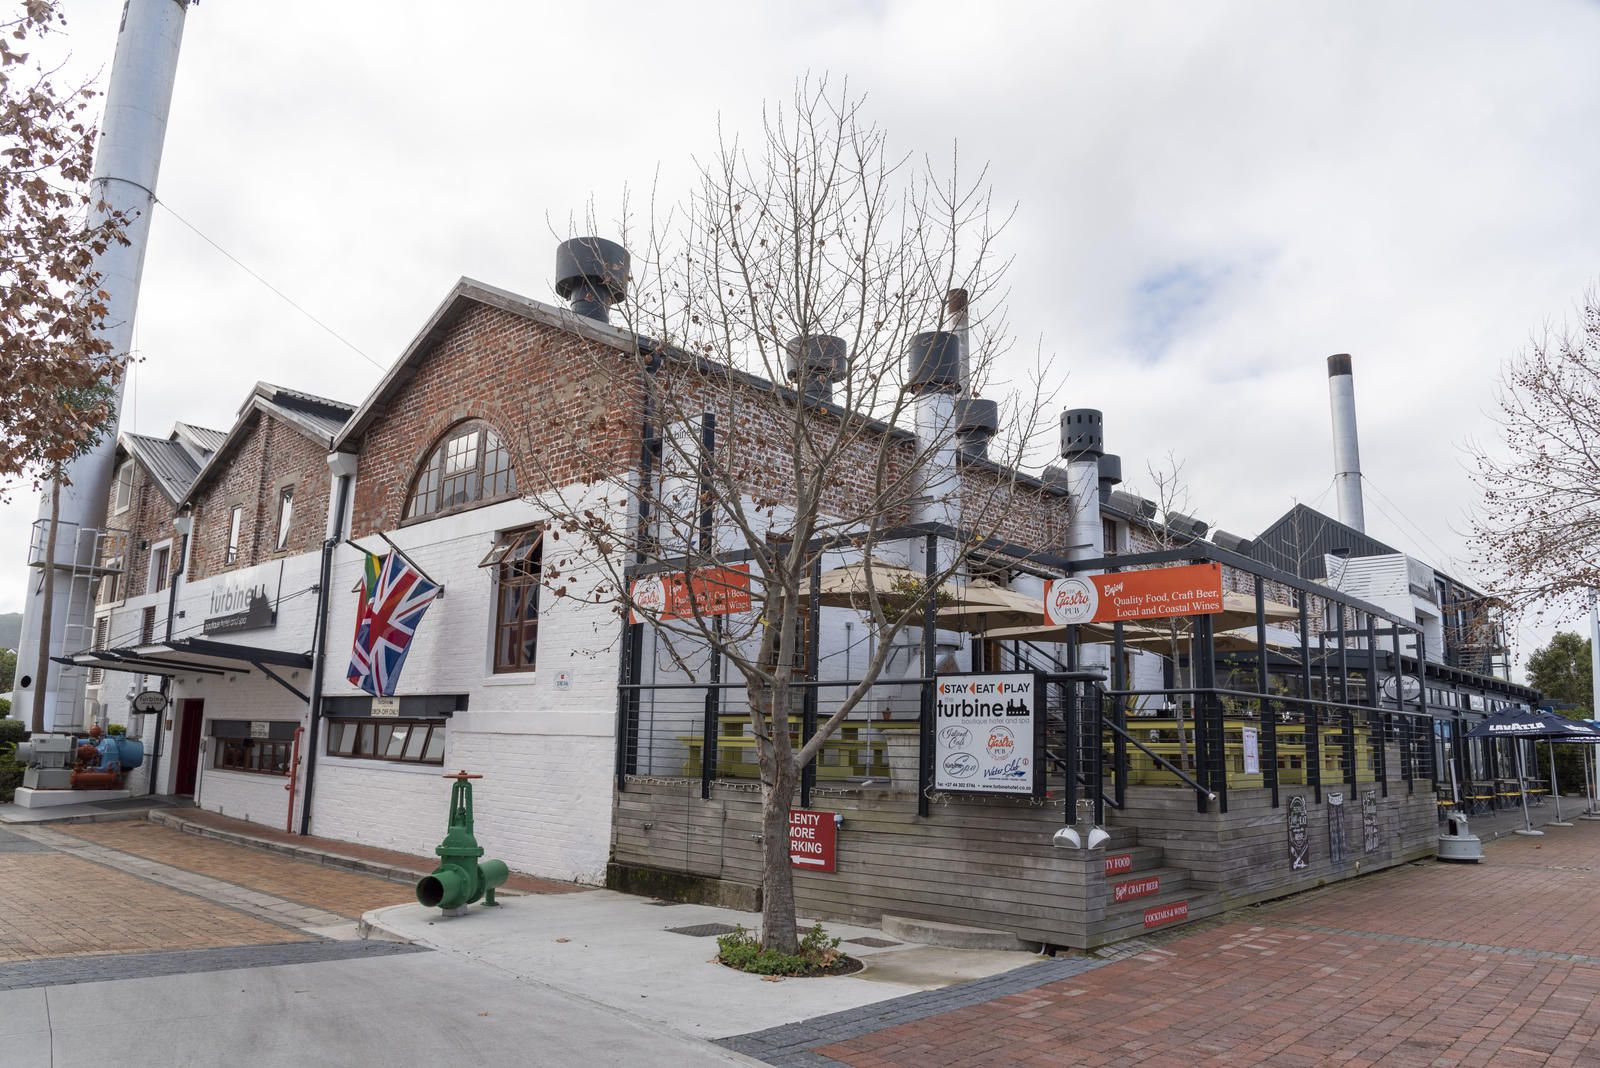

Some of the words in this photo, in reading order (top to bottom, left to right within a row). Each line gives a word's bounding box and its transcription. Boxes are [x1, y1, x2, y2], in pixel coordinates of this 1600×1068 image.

[1104, 582, 1124, 597] Enjoy
[209, 584, 253, 615] turbine
[1056, 590, 1089, 609] Gastro
[1113, 595, 1144, 606] Quality
[1145, 593, 1169, 603] Food,
[1171, 590, 1193, 600] Craft
[1195, 588, 1219, 598] Beer,
[1064, 607, 1080, 615] PUB
[1116, 606, 1139, 617] Local
[1141, 604, 1156, 615] and
[1158, 601, 1190, 613] Coastal
[1192, 600, 1220, 611] Wines
[944, 684, 968, 694] STAY
[976, 683, 995, 693] EAT
[1004, 682, 1031, 693] PLAY
[937, 698, 1004, 718] turbine
[961, 717, 988, 726] boutique
[1004, 717, 1018, 725] and
[1488, 722, 1546, 731] LAVAZZA
[988, 735, 1014, 749] Gastro
[984, 766, 1004, 777] Water
[788, 812, 820, 826] LENTY
[790, 840, 822, 854] RKING
[1114, 857, 1131, 868] FOOD
[1128, 884, 1146, 895] CRAFT
[1146, 880, 1159, 891] BEER
[1145, 910, 1170, 923] COCKTAILS
[1174, 905, 1188, 916] WINES
